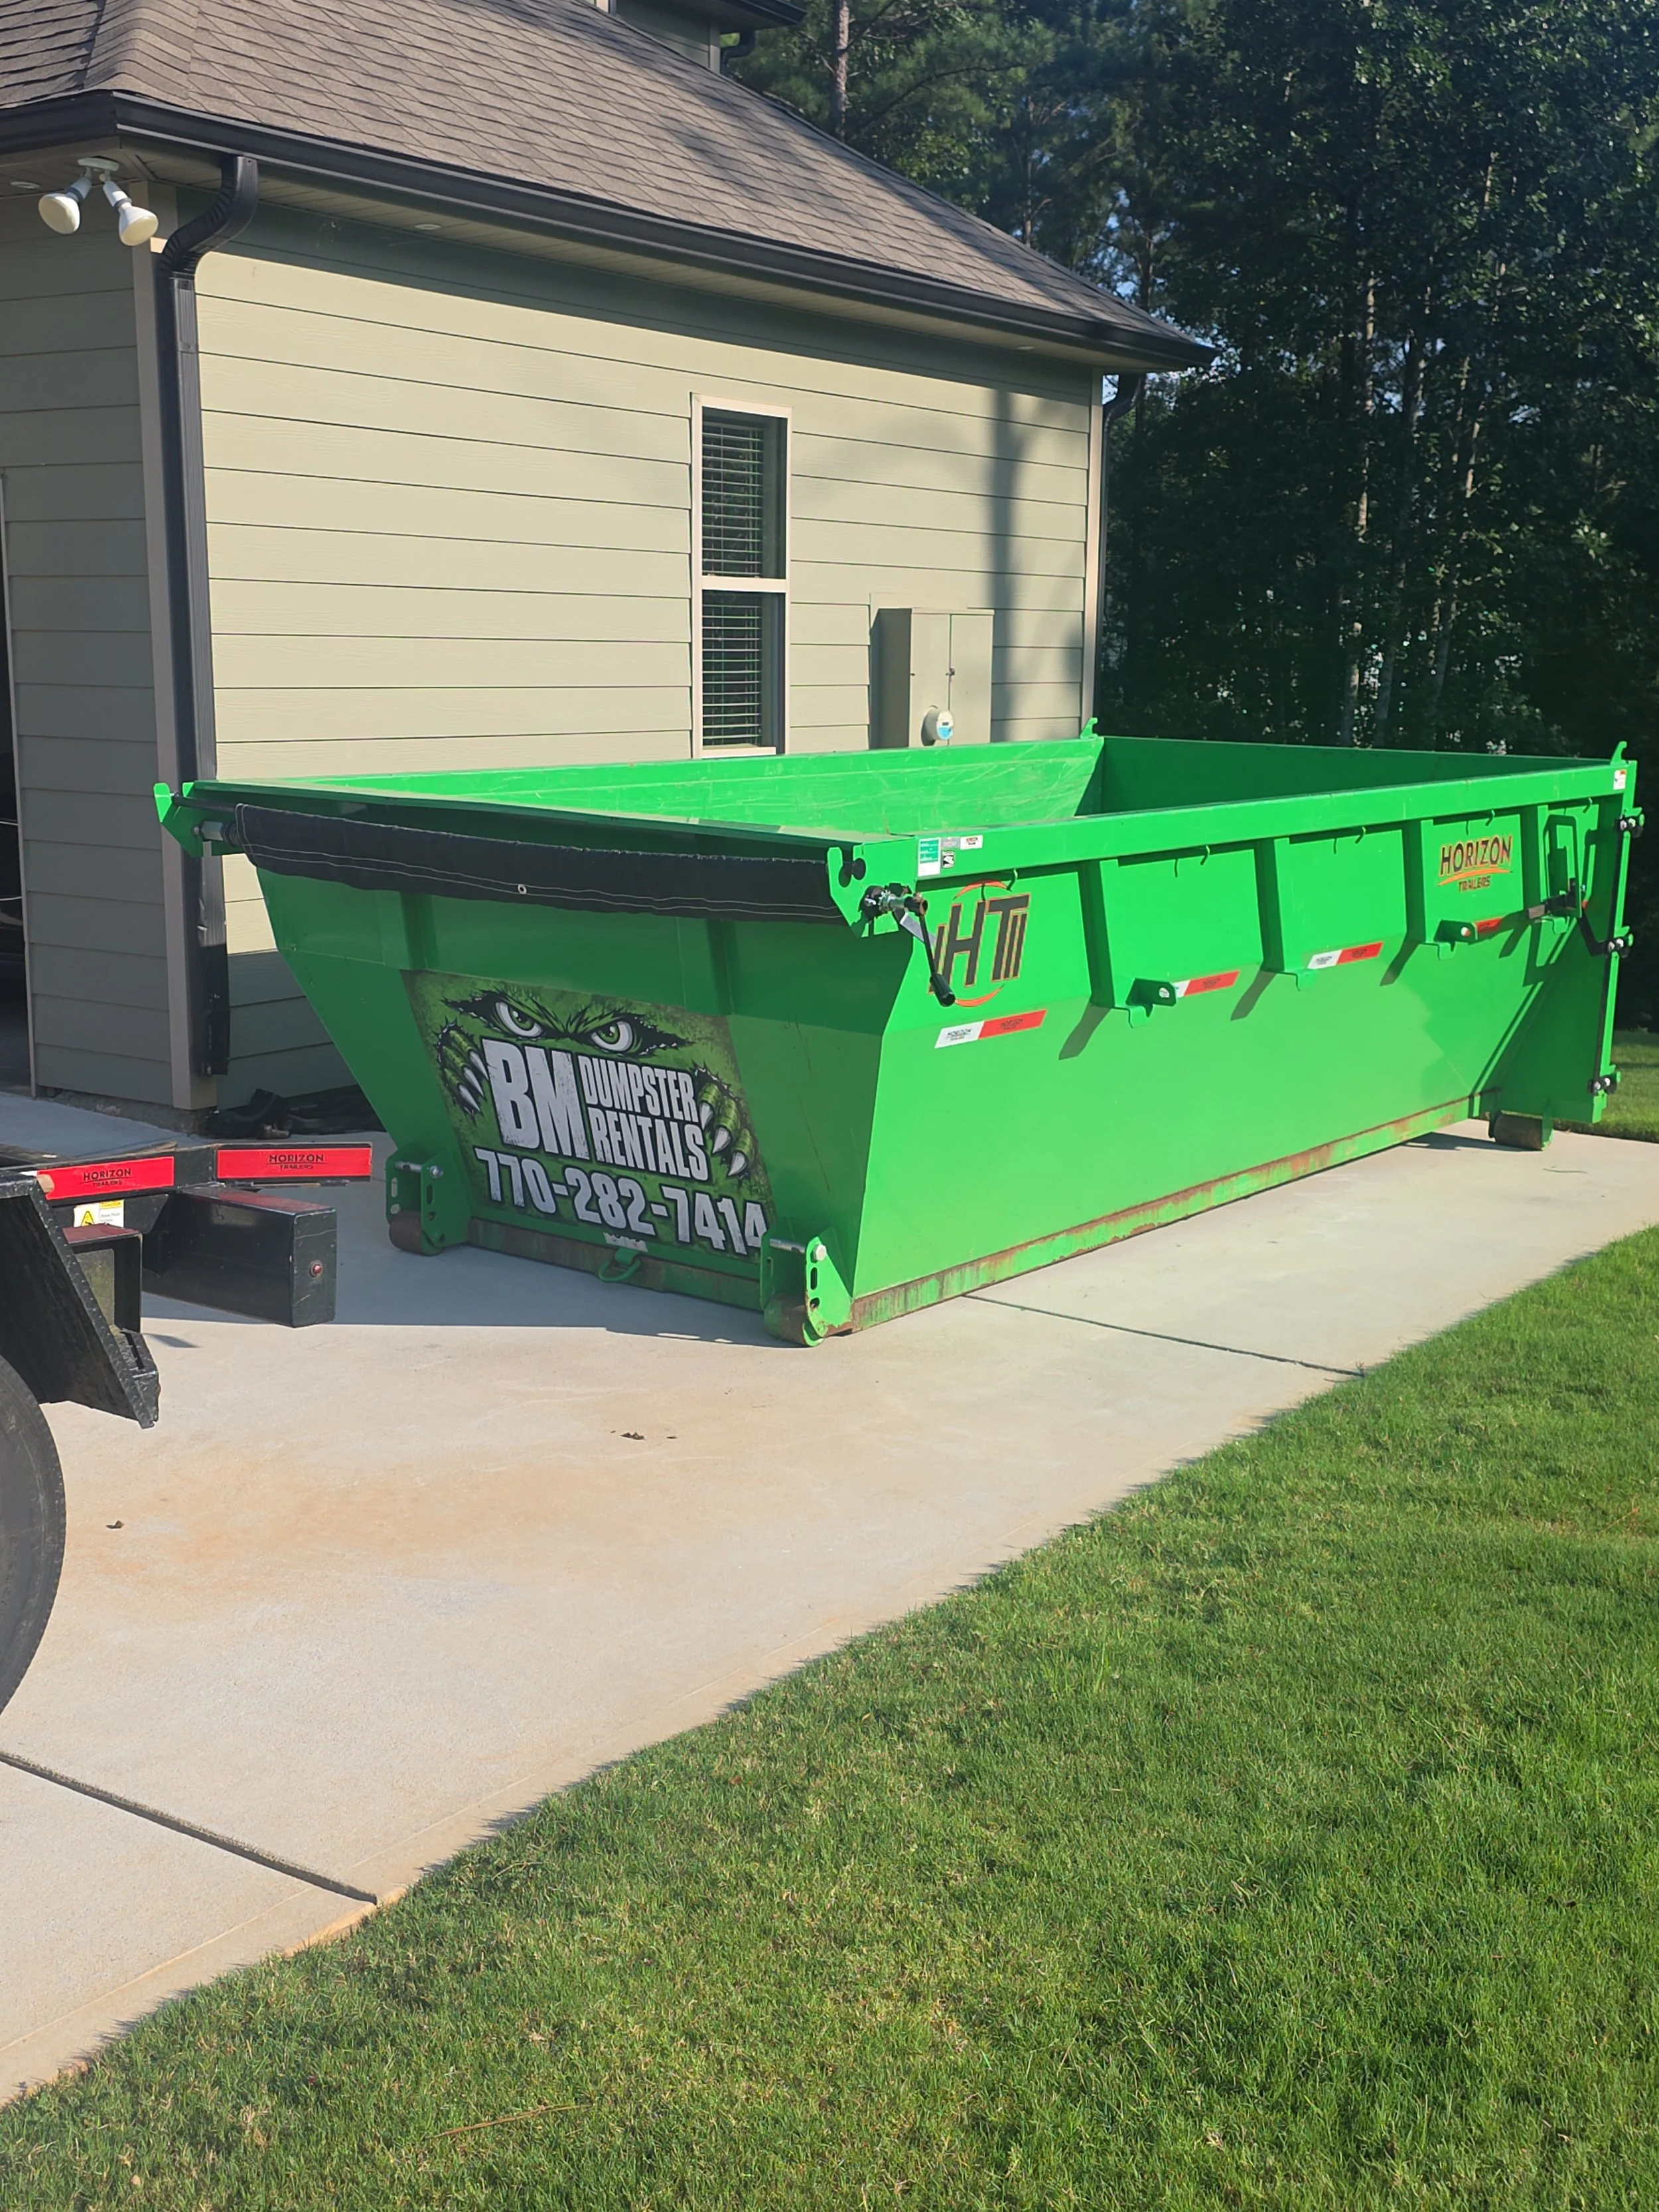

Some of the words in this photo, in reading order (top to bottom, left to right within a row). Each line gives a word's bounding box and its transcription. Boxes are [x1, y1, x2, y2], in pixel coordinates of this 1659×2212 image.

[1439, 834, 1512, 877] HORIZON
[1458, 875, 1491, 892] TRAILERS
[482, 1038, 591, 1160] BM
[577, 1055, 700, 1123] DUMPSTER
[269, 1153, 325, 1163] HORIZON
[588, 1106, 709, 1181] RENTALS
[82, 1168, 131, 1181] HORIZON
[474, 1147, 768, 1256] 770-282-7414
